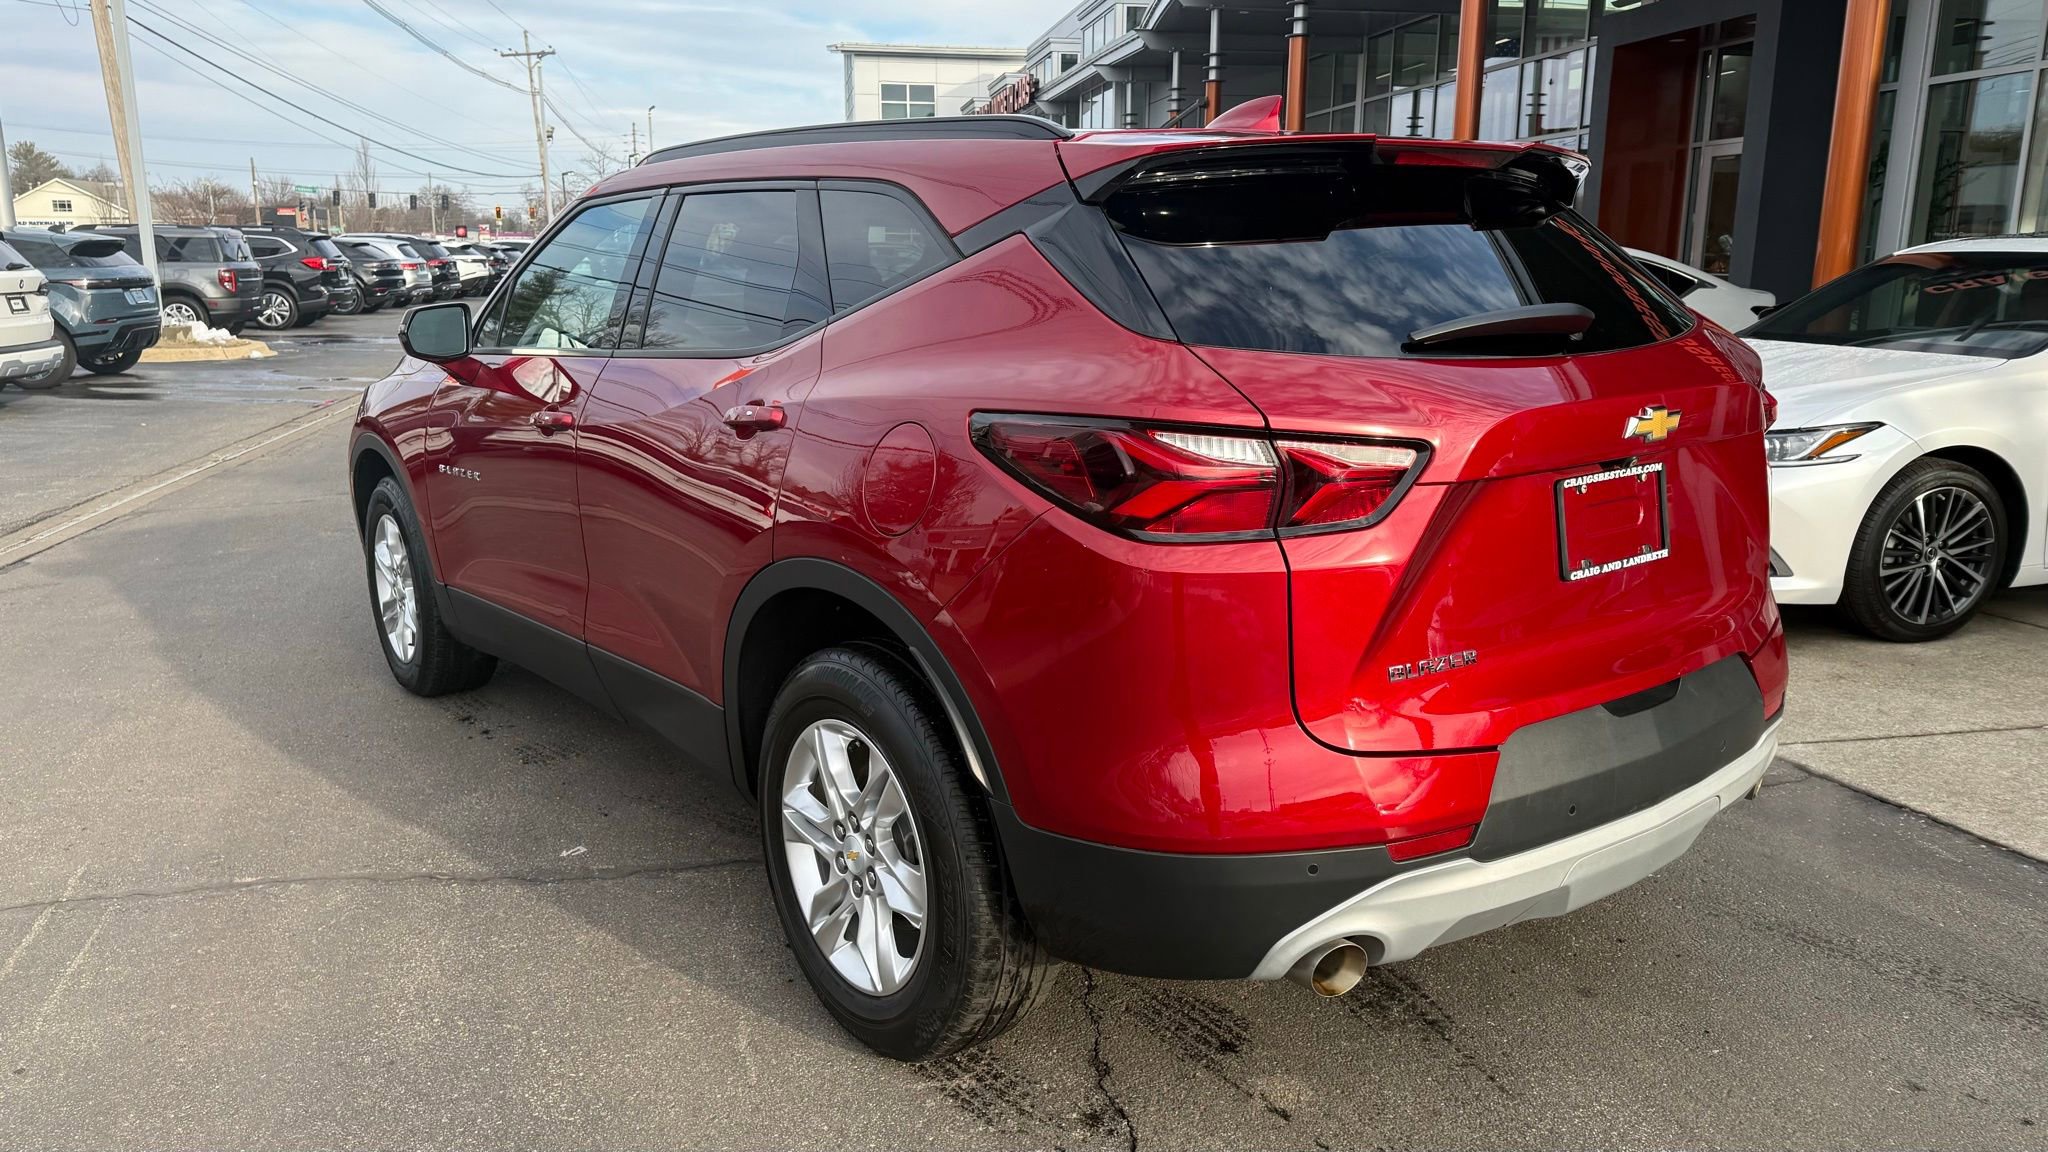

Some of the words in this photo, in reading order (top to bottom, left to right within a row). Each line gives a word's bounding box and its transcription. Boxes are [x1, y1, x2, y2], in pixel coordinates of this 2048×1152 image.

[438, 463, 481, 481] BLAZER
[1563, 462, 1663, 489] CRAIGSBESTCARS.COM
[1570, 566, 1600, 581] CRAIG
[1601, 561, 1622, 573] AND
[1622, 549, 1669, 568] LANDRETH
[1387, 648, 1477, 683] BLAZER
